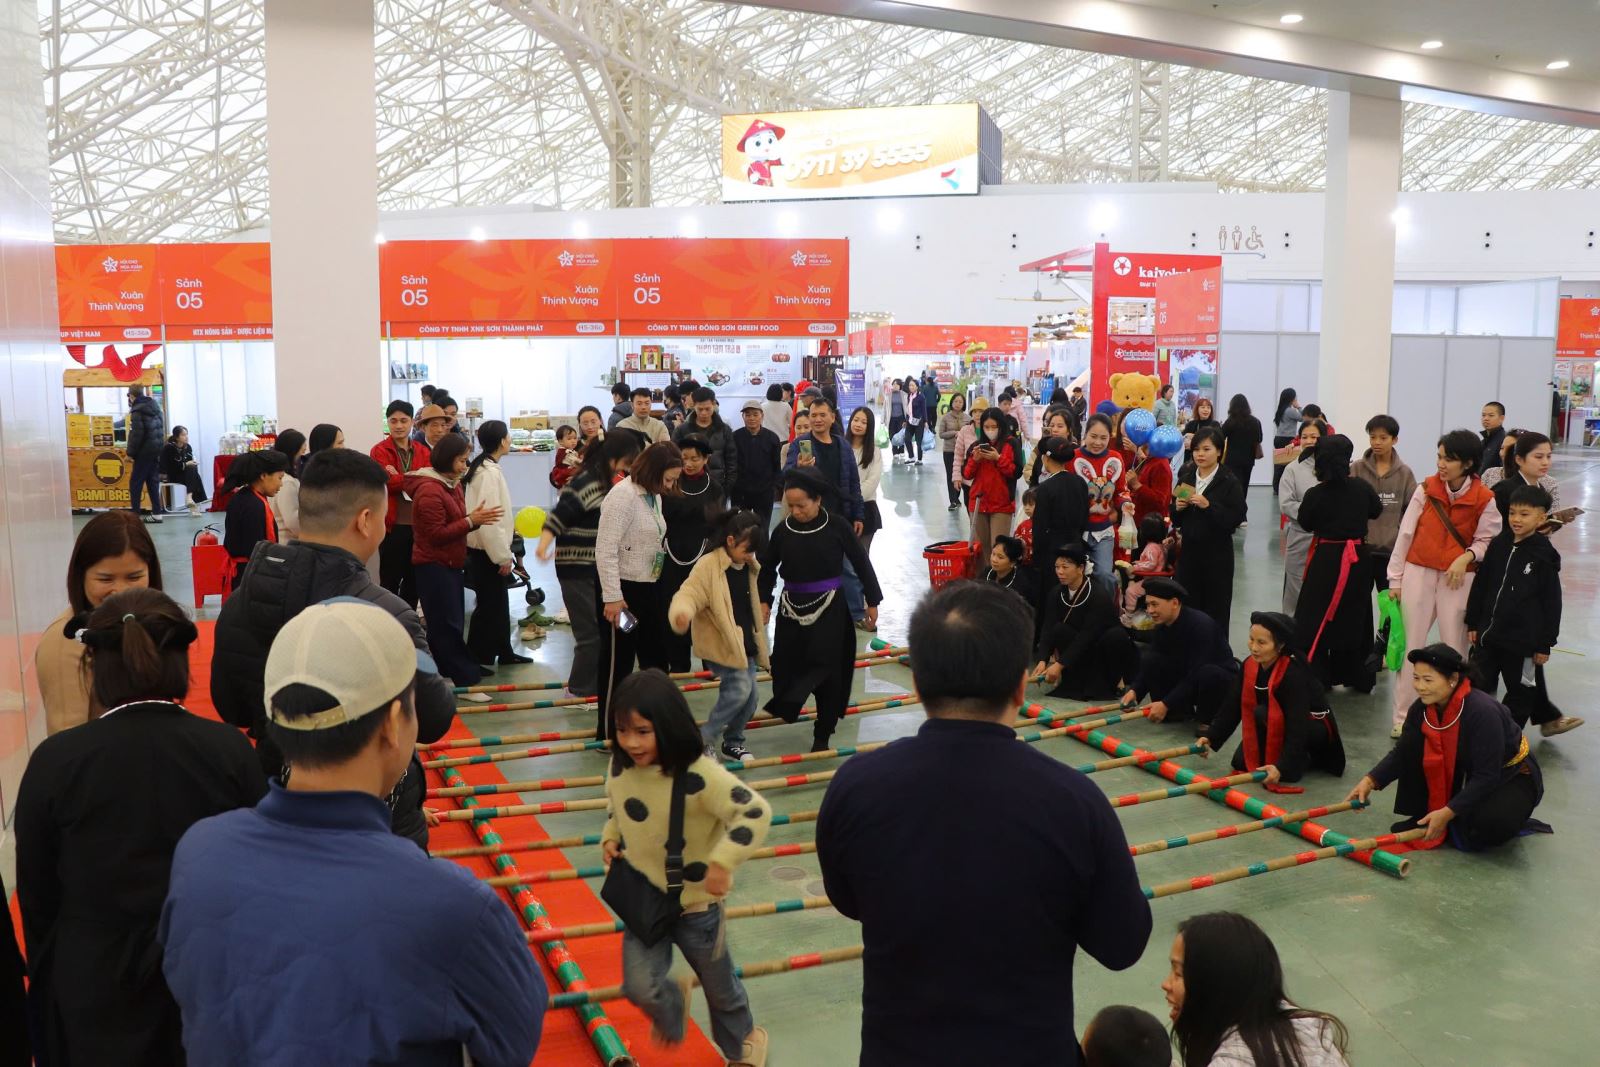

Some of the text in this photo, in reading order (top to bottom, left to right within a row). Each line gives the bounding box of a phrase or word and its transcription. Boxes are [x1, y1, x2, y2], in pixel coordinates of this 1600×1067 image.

[840, 147, 870, 174] 39
[870, 142, 932, 169] 5555
[176, 278, 202, 288] Sảnh
[401, 275, 428, 284] Sảnh
[634, 274, 661, 283] Sảnh
[120, 291, 144, 299] Xuân
[575, 286, 598, 294] Xuân
[176, 292, 203, 309] 05
[401, 289, 428, 306] 05
[634, 287, 661, 304] 05
[542, 297, 598, 306] Thịnh Vượng
[775, 296, 831, 306] Thịnh Vượng
[89, 302, 144, 312] Thịnh Vượng
[71, 330, 83, 338] VIỆT
[77, 489, 105, 501] BAMI
